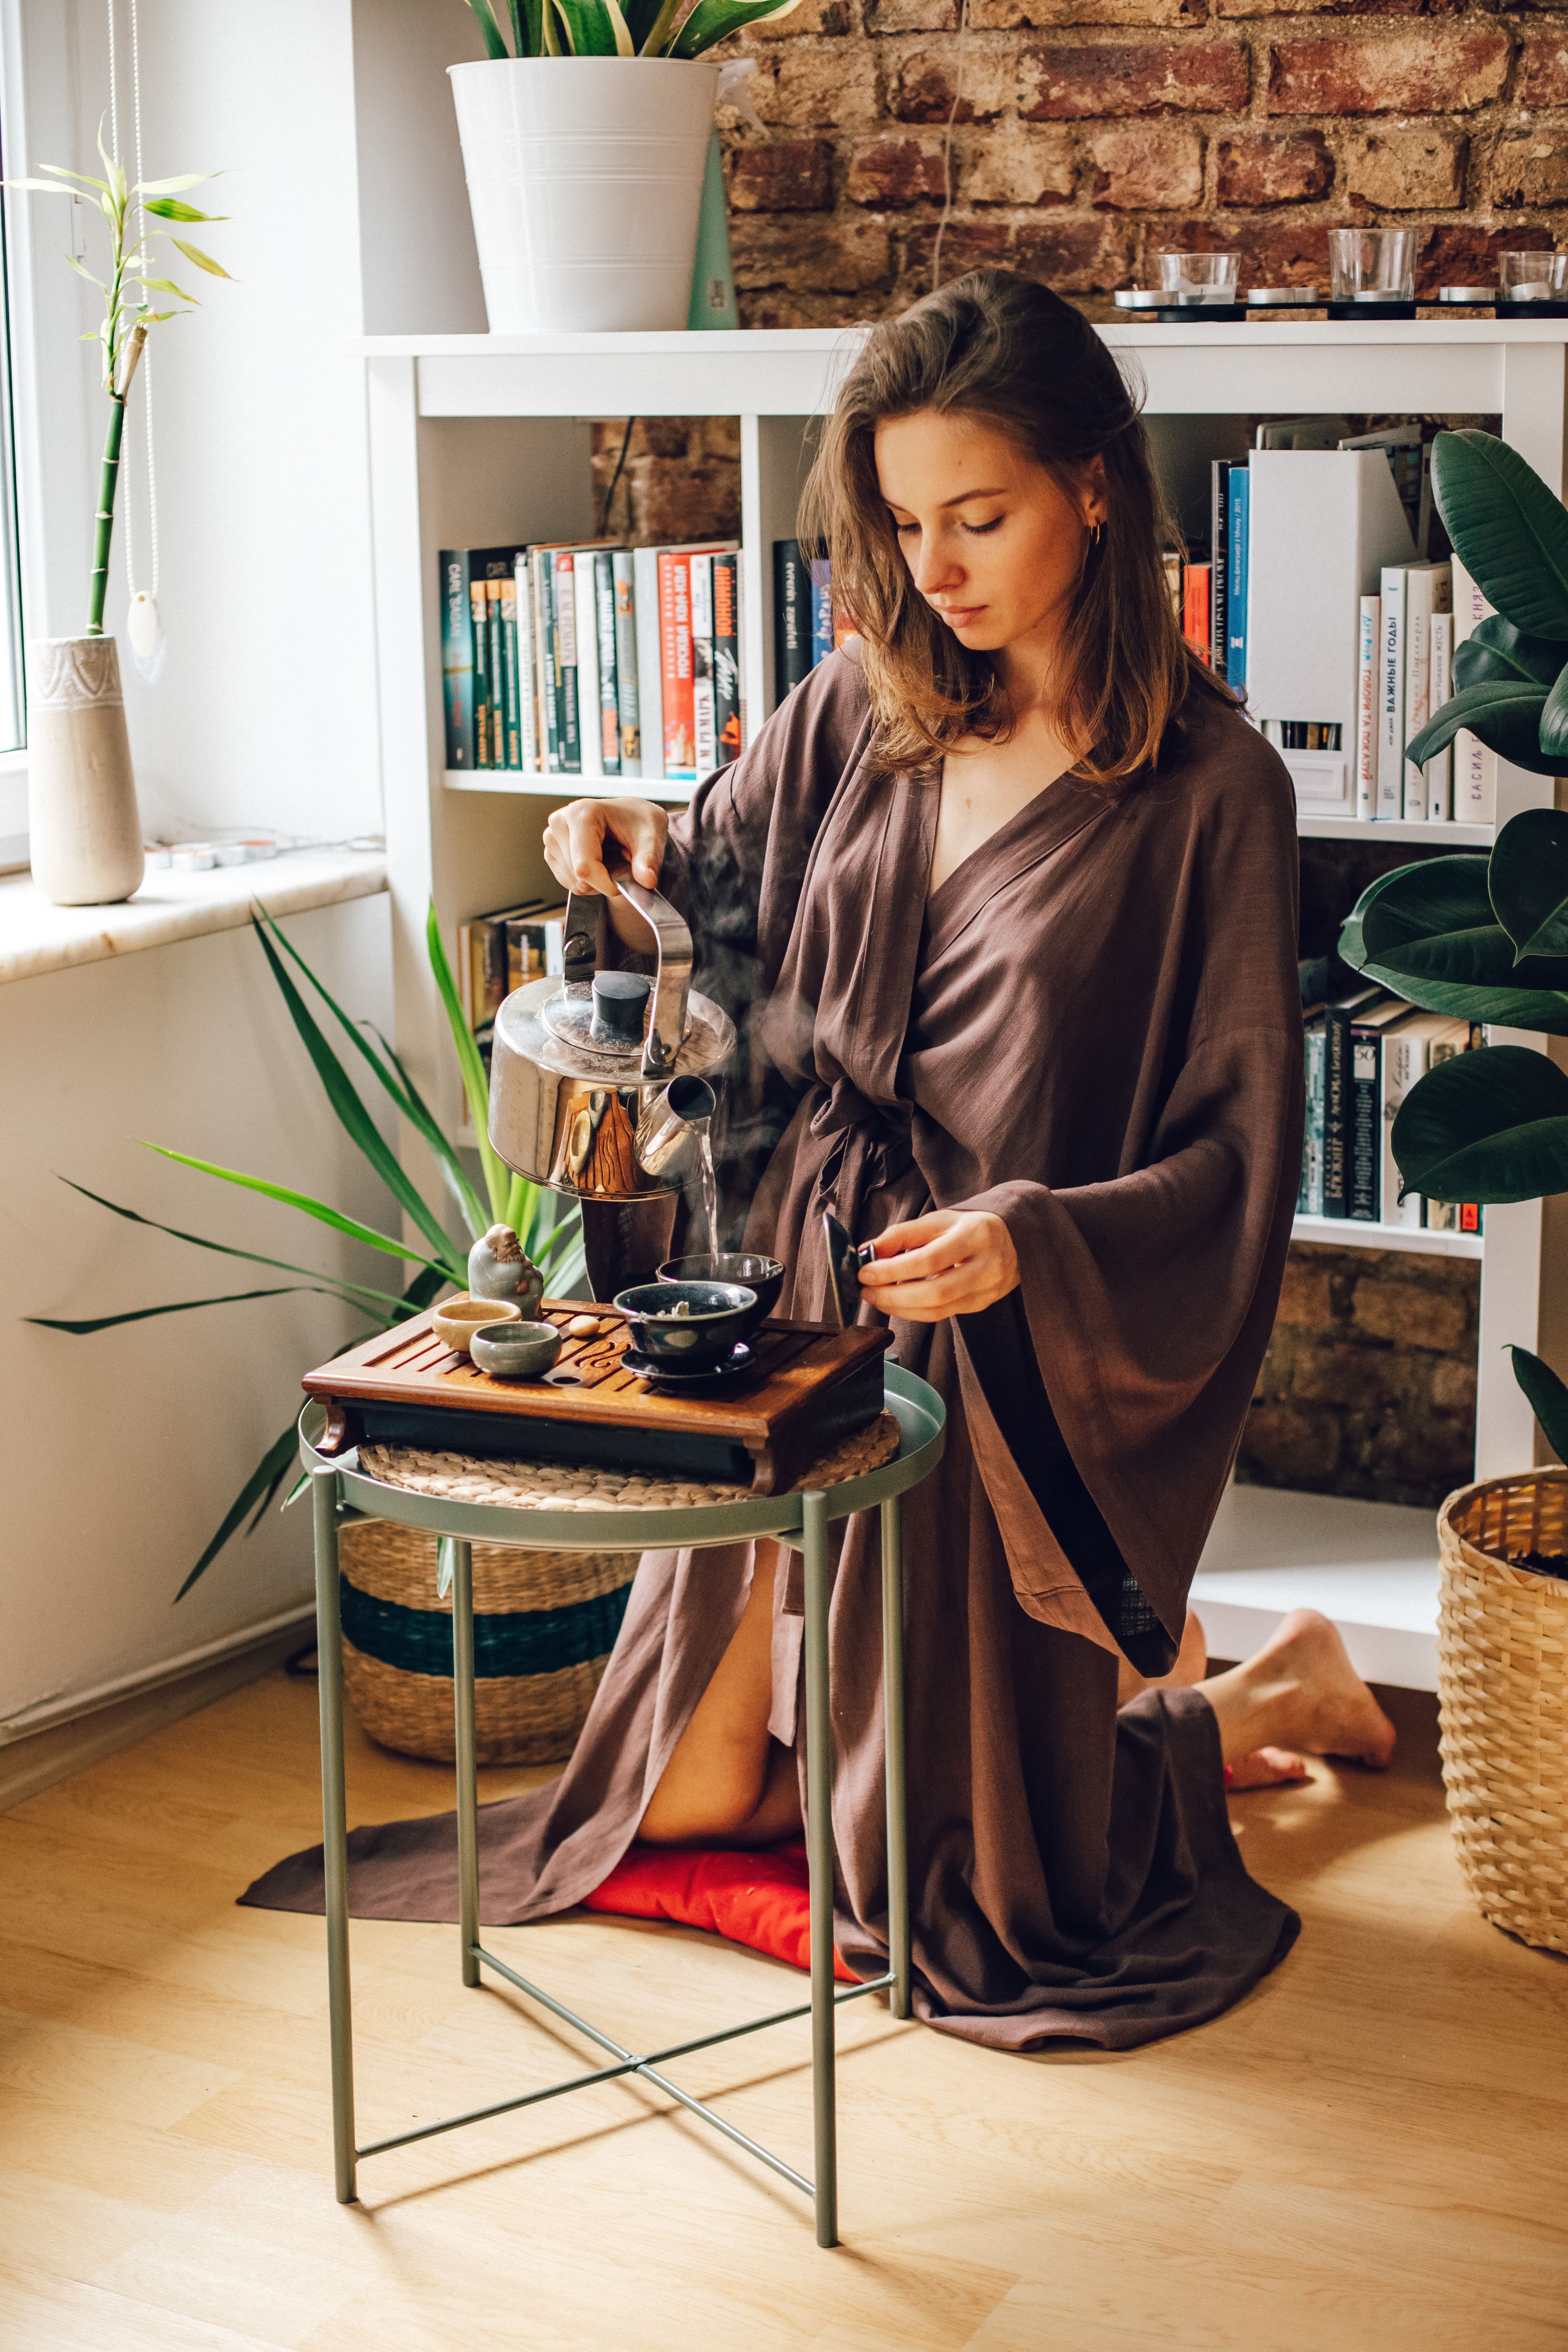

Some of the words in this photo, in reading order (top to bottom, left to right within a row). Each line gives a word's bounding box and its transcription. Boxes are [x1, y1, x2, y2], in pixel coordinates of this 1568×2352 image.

[448, 564, 461, 593] CARL
[674, 565, 687, 622] КВА-КВА
[714, 565, 732, 636] ЛИМОНОВ
[675, 626, 690, 678] МОСКВА
[1387, 617, 1396, 653] ГОДЫ
[1363, 670, 1372, 710] ГОВОРИ
[1387, 659, 1396, 712] ВАЖНЫЕ
[1363, 714, 1372, 726] ТА
[1362, 732, 1373, 781] ПОКАЗУЙ
[1471, 750, 1482, 800] ВАСИЛЬ
